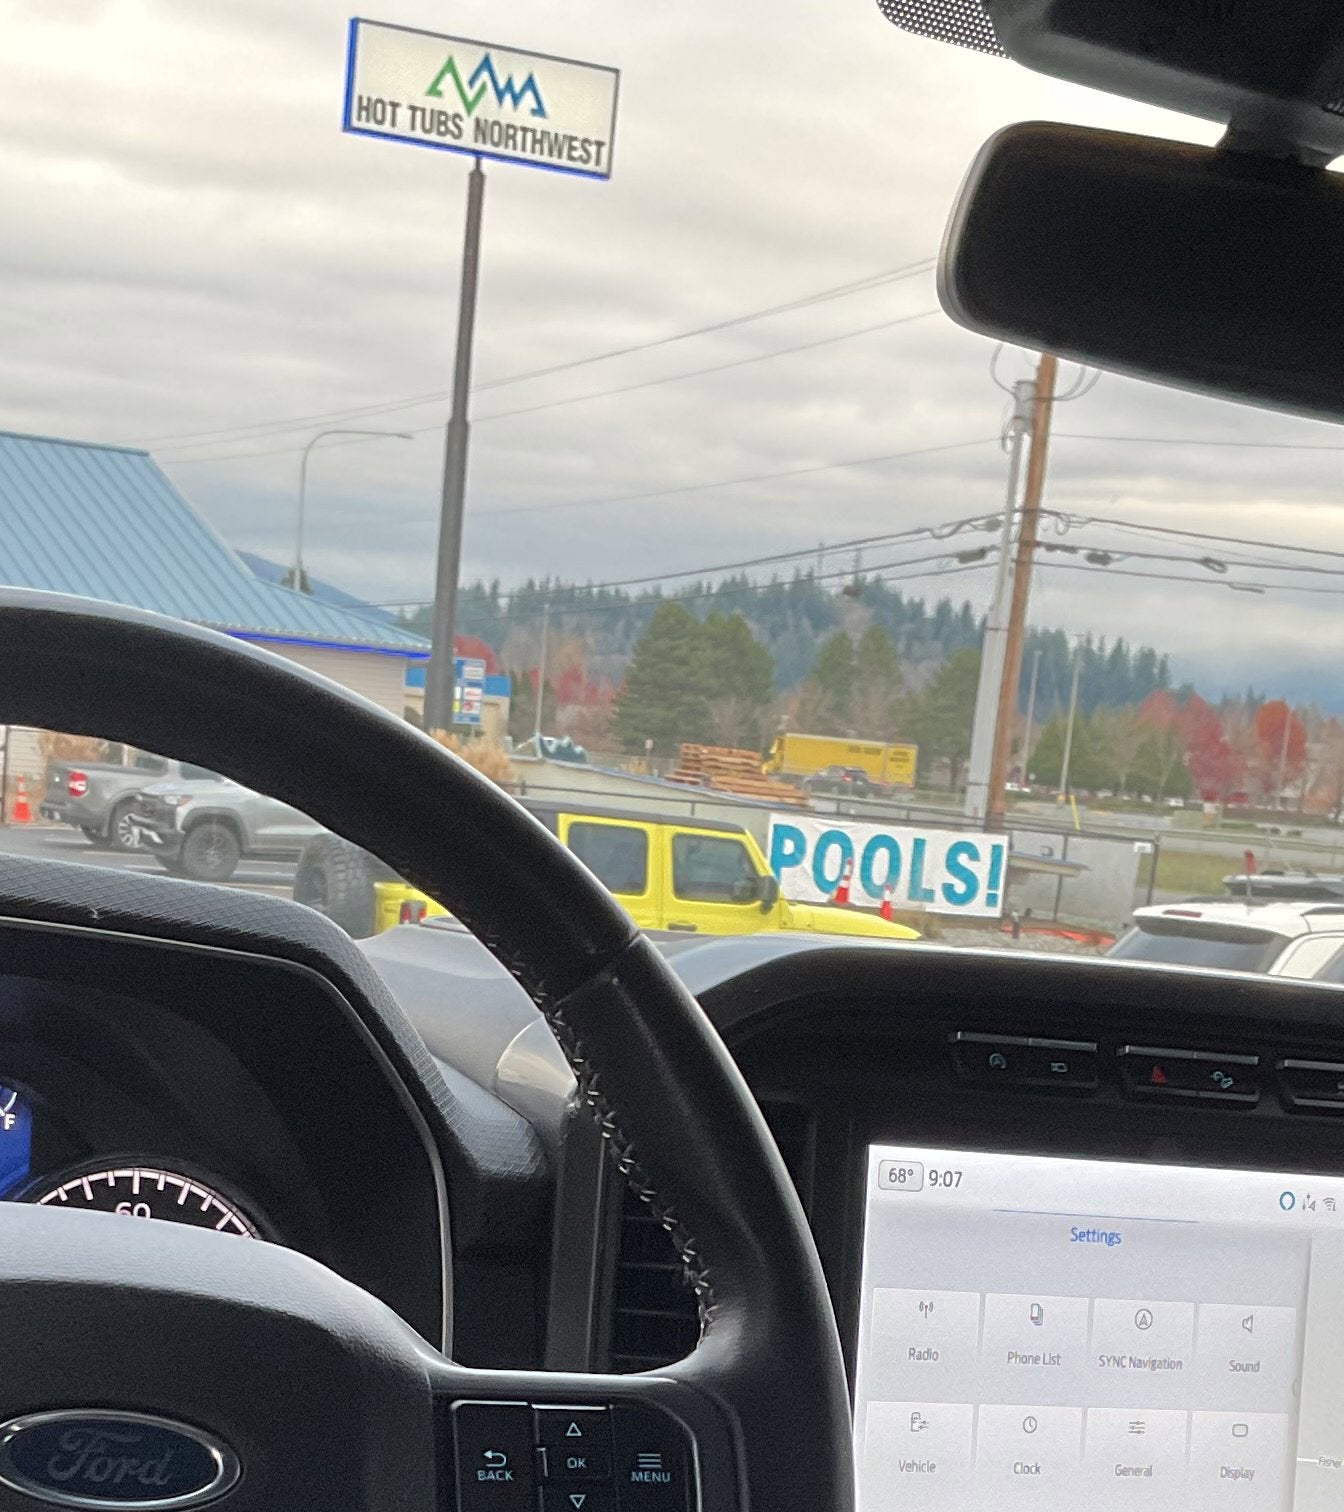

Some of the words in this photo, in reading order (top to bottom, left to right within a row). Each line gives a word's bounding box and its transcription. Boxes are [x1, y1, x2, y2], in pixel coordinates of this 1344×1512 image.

[357, 95, 401, 128] HOT
[408, 104, 463, 140] TUBS
[474, 117, 606, 167] NORTHWEST
[769, 823, 1005, 908] POOLS!
[4, 1113, 16, 1130] F
[888, 1167, 914, 1184] 68°
[929, 1169, 963, 1188] 9:07
[1070, 1227, 1122, 1247] Settings
[908, 1347, 939, 1362] Radio
[1007, 1351, 1041, 1365] Phone
[1043, 1352, 1061, 1366] List
[1098, 1355, 1127, 1368] SYNC
[1129, 1356, 1183, 1371] Navigation
[1229, 1360, 1260, 1373] Sound
[47, 1427, 175, 1485] Ford
[567, 1457, 586, 1469] OK
[899, 1459, 936, 1473] Vehicle
[1013, 1461, 1041, 1475] Clock
[1114, 1463, 1153, 1477] General
[1220, 1466, 1255, 1481] Display
[477, 1470, 513, 1481] BACK
[631, 1471, 671, 1483] MENU
